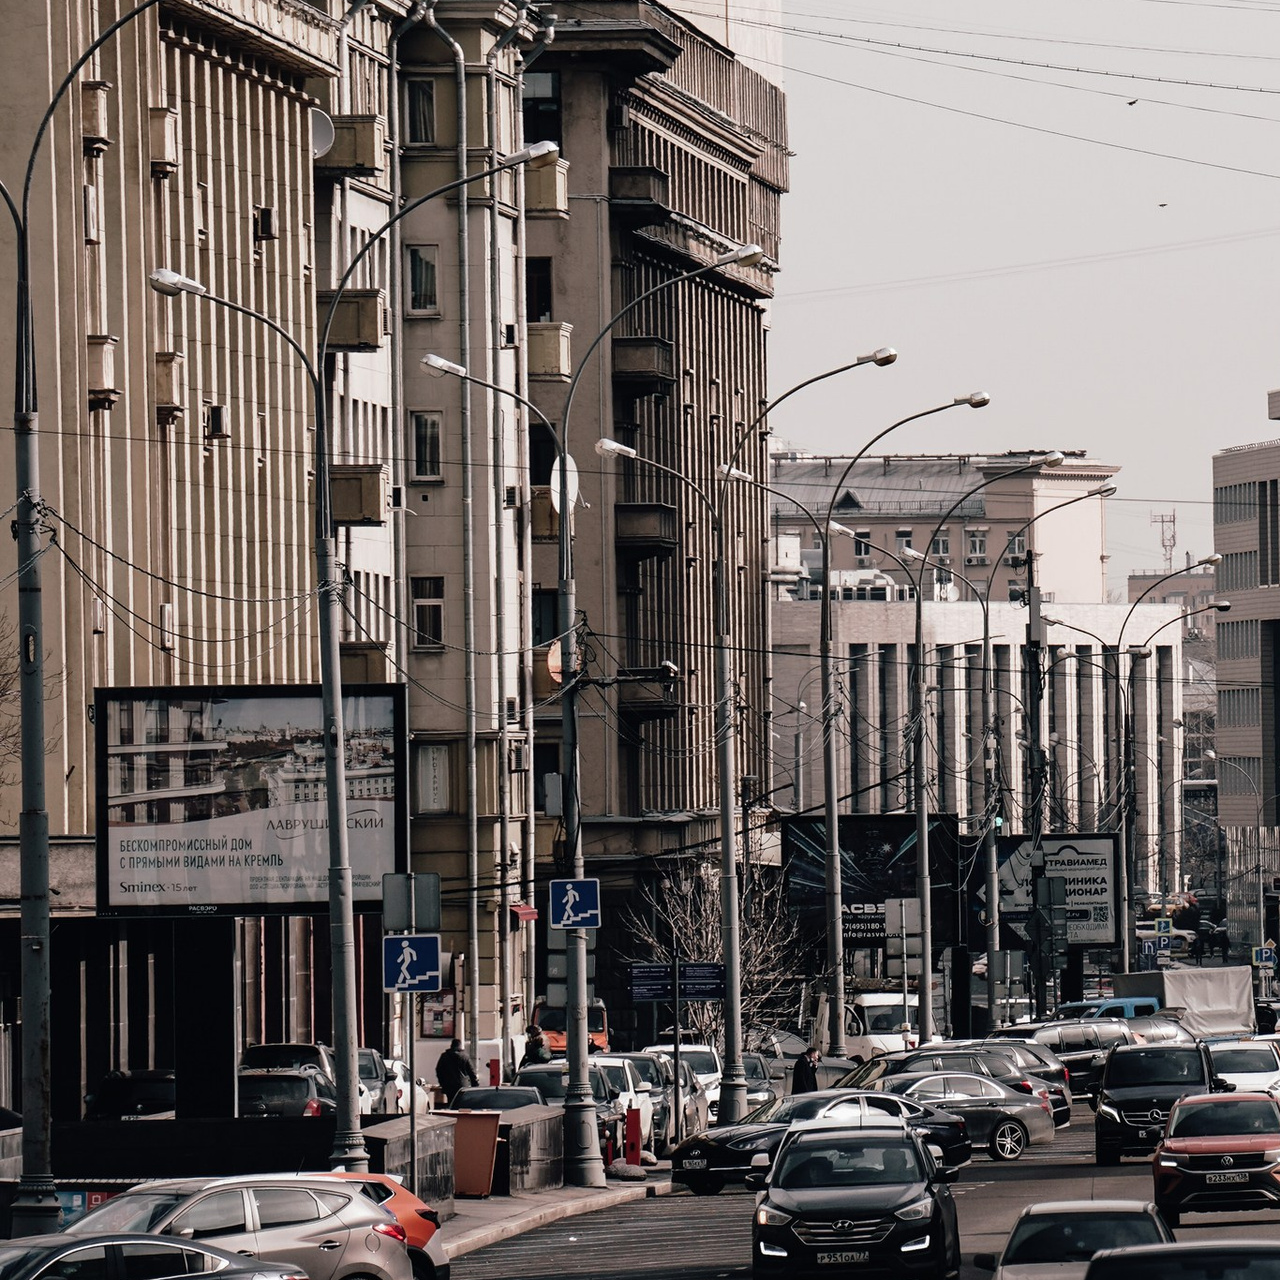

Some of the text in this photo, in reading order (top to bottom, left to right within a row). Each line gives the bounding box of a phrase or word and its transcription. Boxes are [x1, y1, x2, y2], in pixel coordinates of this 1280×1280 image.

[120, 835, 253, 853] БЕСКОМПРОМИССНЫЙ ДОМ
[120, 854, 284, 869] С ПРЯМЫМИ ВИДАМИ НА КРЕМЛЬ
[120, 881, 166, 893] Sminex
[171, 883, 182, 892] 15
[1068, 923, 1109, 931] ЕОБХОДИМА
